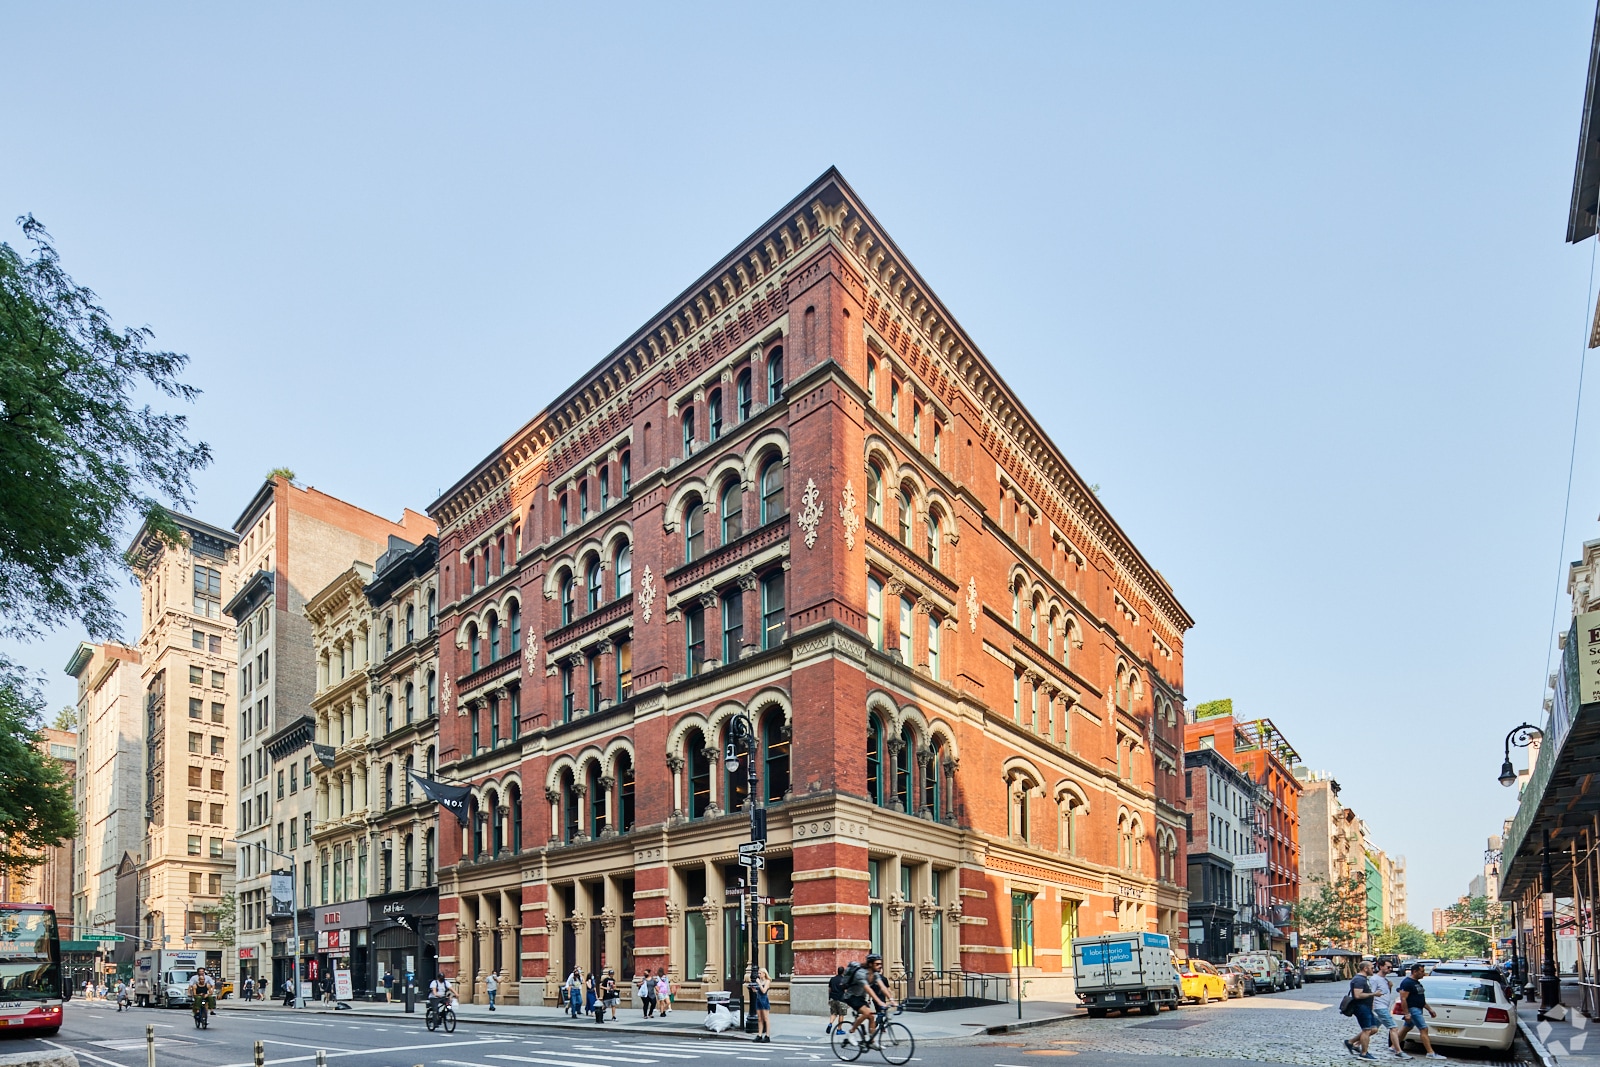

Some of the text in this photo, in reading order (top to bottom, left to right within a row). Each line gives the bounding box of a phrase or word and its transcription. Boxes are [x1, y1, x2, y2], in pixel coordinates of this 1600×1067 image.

[240, 947, 254, 959] GNC
[1089, 947, 1123, 956] laboratorio
[1109, 953, 1129, 962] gelato
